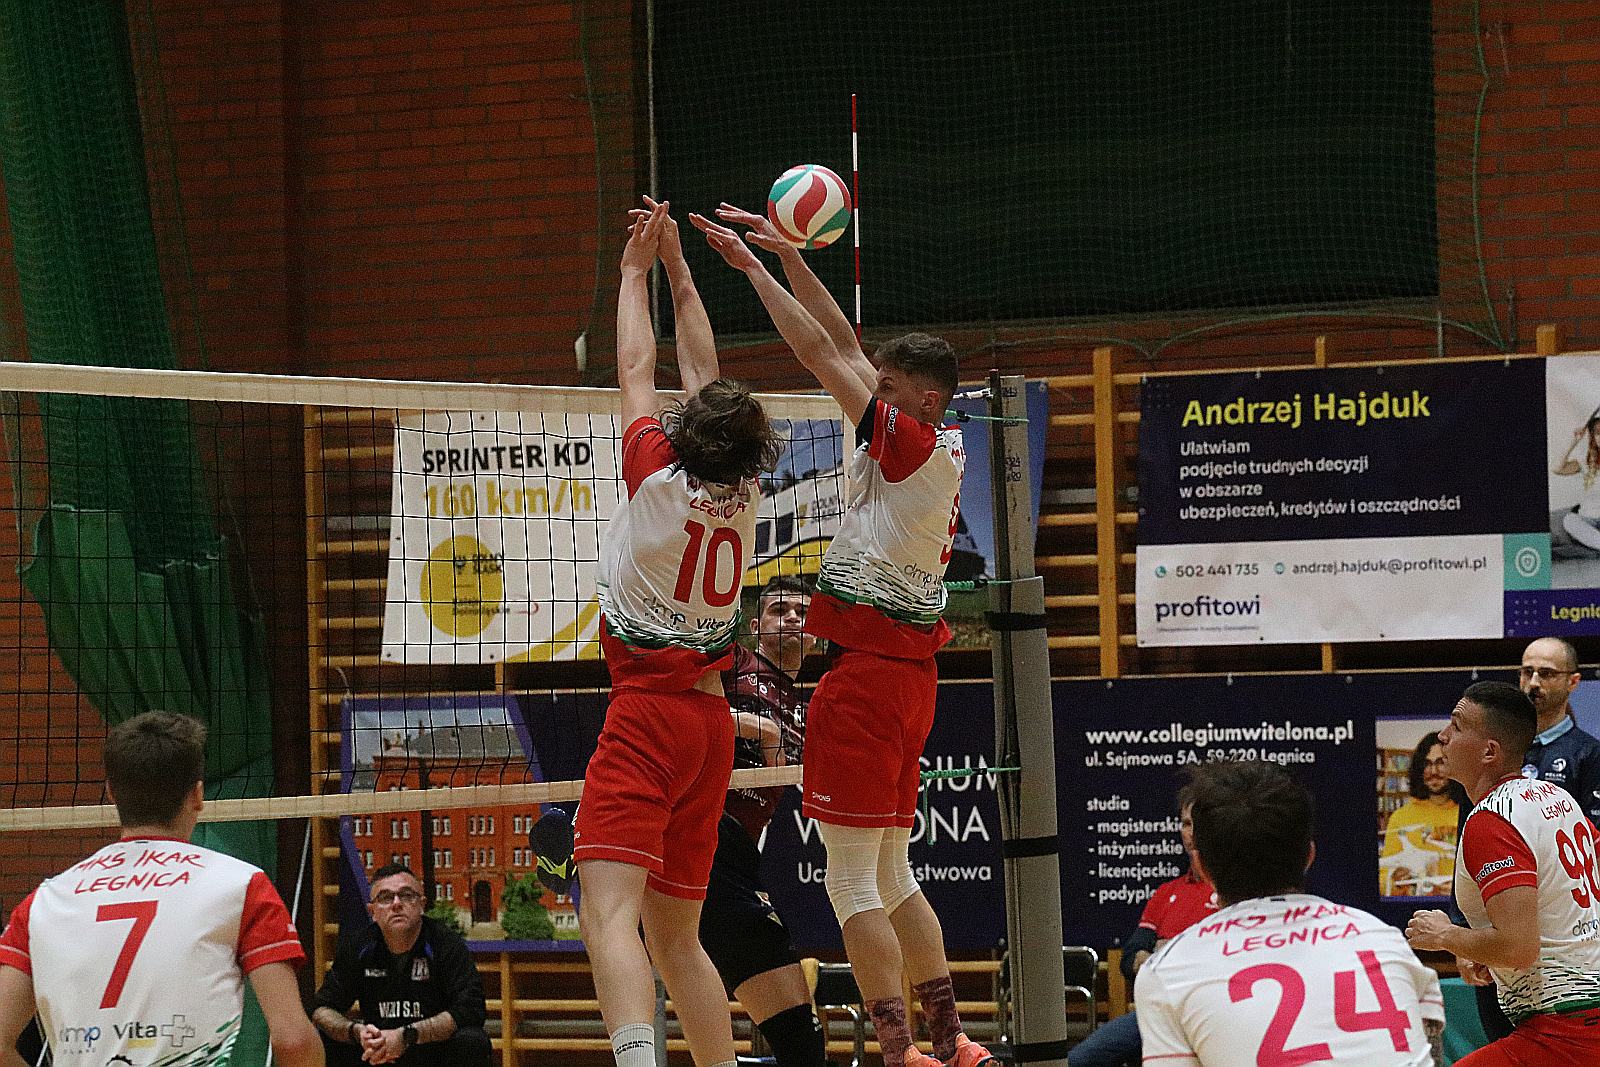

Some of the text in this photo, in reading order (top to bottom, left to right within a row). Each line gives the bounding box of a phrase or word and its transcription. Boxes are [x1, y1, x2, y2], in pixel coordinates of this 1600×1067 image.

[1181, 390, 1430, 429] Andrzej Hajduk
[422, 442, 591, 473] SPRINTER KD
[1180, 455, 1368, 480] podjęcie trudnych decyzji
[423, 480, 591, 516] 160 km/h
[1180, 483, 1263, 498] w obszarze
[1281, 499, 1347, 518] kredytów
[1357, 495, 1461, 515] oszczędności
[673, 519, 743, 607] 10
[1176, 563, 1259, 577] 502 441 735
[1155, 594, 1260, 622] profitowi
[1085, 720, 1354, 746] www.collegiumwitelona.pl
[1085, 752, 1102, 766] ul.
[1106, 751, 1174, 770] Sejmowa
[1176, 750, 1201, 766] 5A,
[1261, 747, 1316, 767] Legnica
[1087, 795, 1130, 811] studia
[73, 849, 205, 873] MKS IKAR
[1098, 839, 1183, 859] inżynierskie
[74, 871, 189, 894] LEGNICA
[909, 861, 992, 882] stwowa
[1098, 861, 1180, 881] licencjackie
[1222, 922, 1361, 956] LEGNICA
[95, 900, 158, 1009] 7
[1228, 950, 1411, 1067] 24
[113, 1021, 158, 1039] Vita
